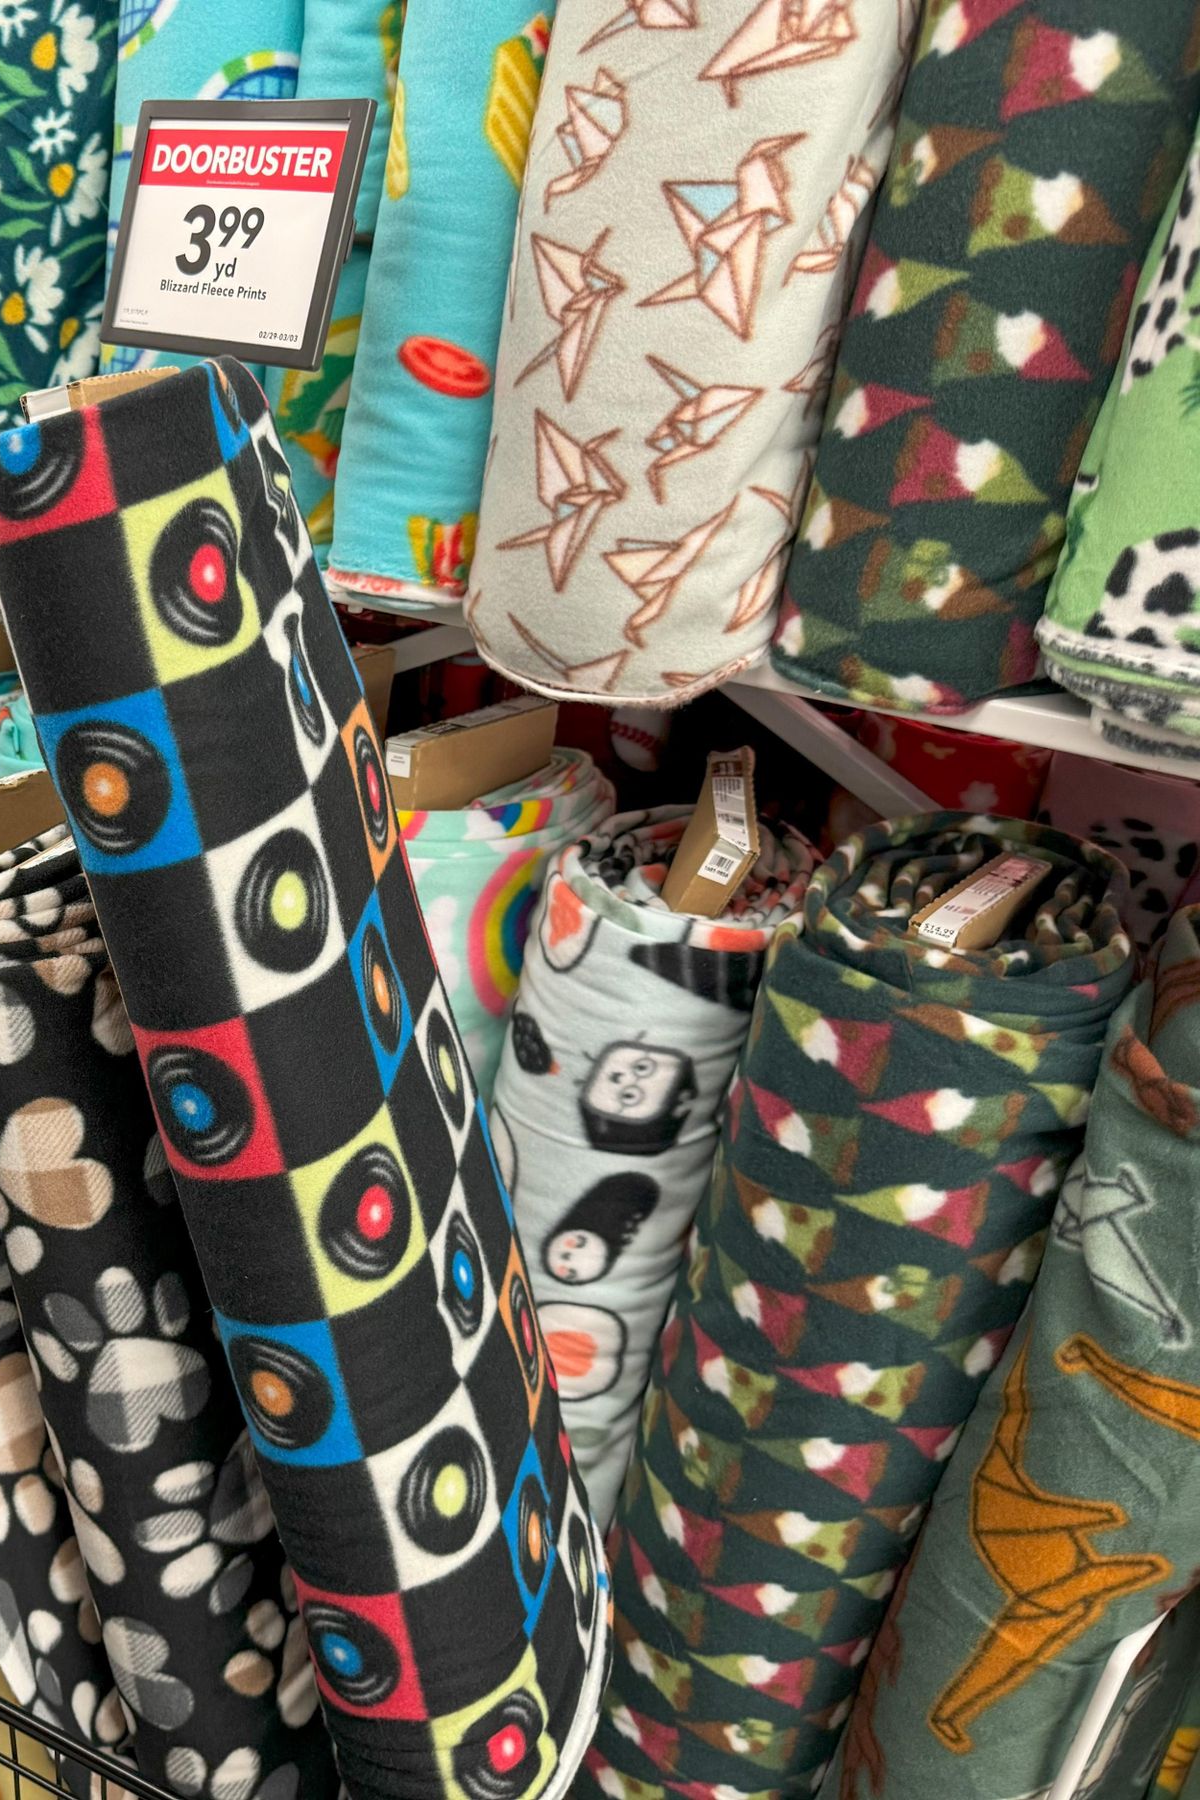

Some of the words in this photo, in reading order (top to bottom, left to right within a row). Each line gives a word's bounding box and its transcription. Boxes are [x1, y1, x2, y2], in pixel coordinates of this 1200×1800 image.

[151, 144, 332, 178] DOORBUSTER
[213, 257, 238, 282] yd
[159, 279, 200, 294] Blizzard
[201, 283, 234, 298] Fleece
[237, 286, 267, 301] Prints
[258, 330, 298, 343] 02/29-03/03
